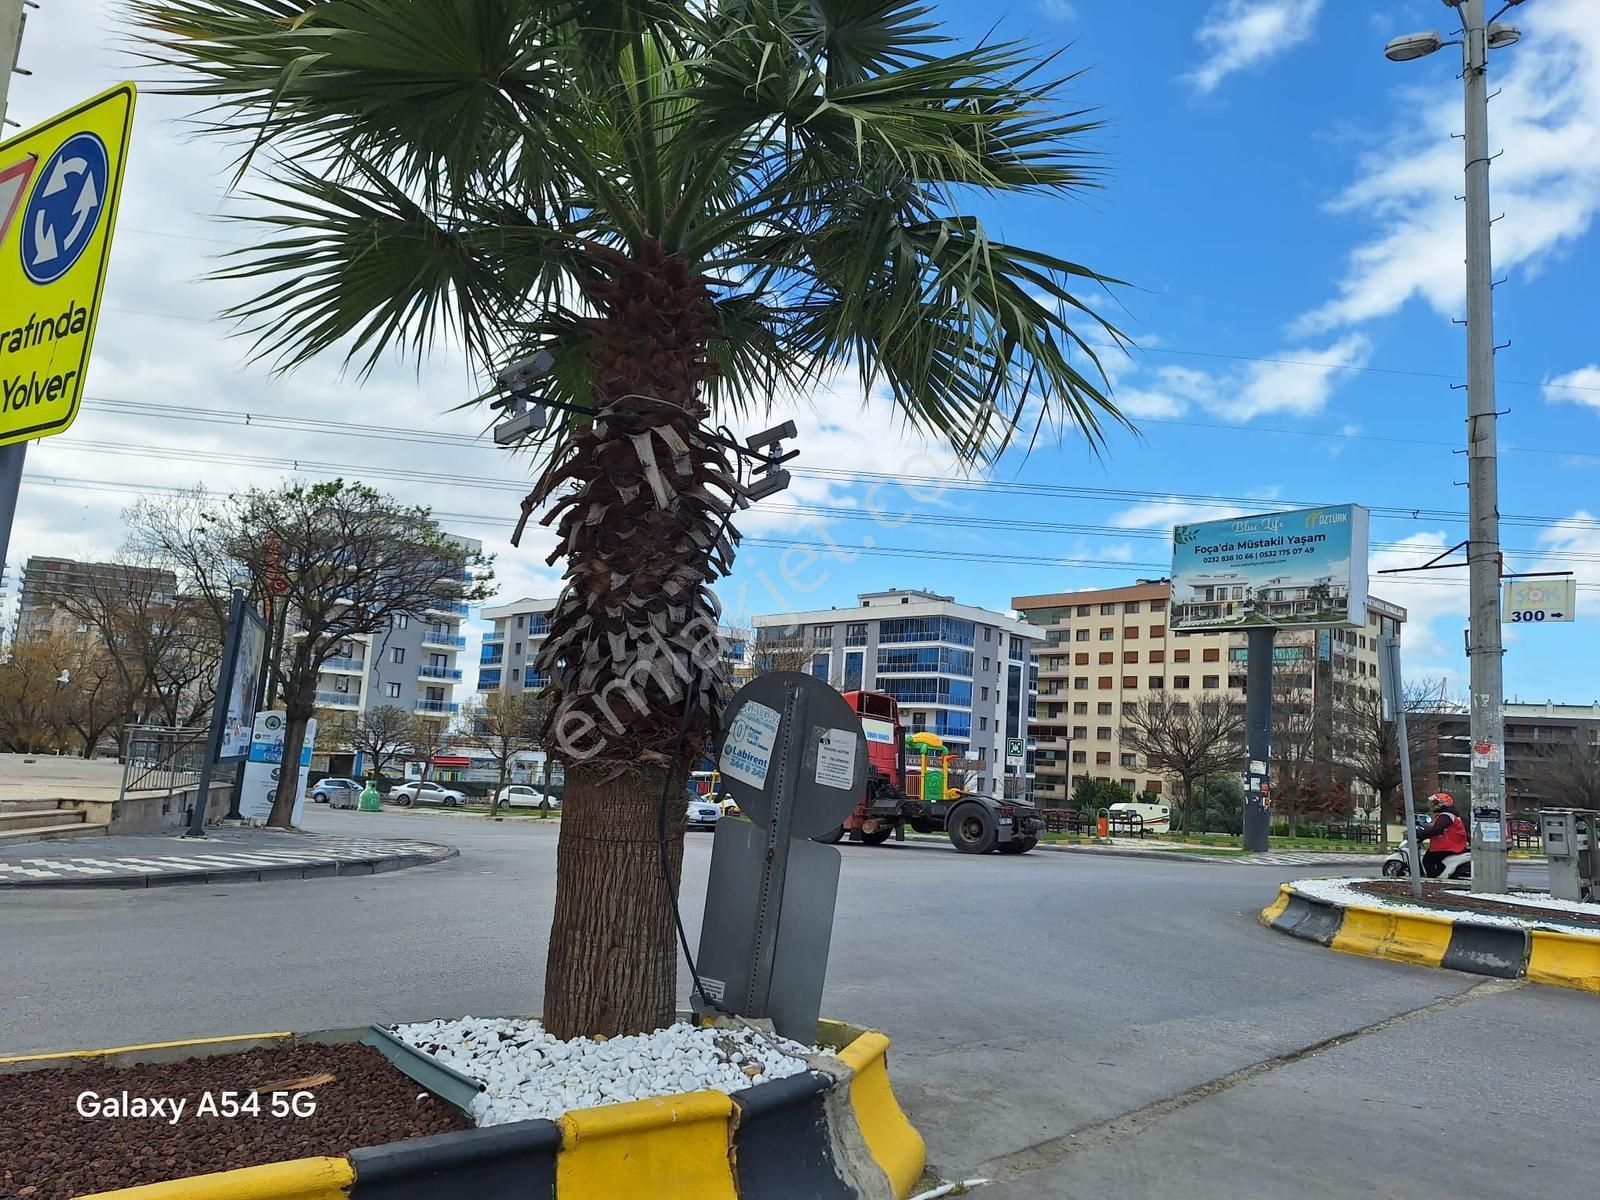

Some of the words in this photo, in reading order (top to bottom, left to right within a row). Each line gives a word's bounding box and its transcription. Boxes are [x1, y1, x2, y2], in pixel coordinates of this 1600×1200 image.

[2, 370, 77, 414] Yolver
[1232, 520, 1259, 533] Blue
[1261, 517, 1285, 533] Life
[1319, 512, 1347, 525] ÖZTÜRK
[1194, 543, 1235, 555] Foça'da
[1237, 536, 1284, 550] Müstakil
[1287, 532, 1326, 545] Yaşam
[1203, 556, 1220, 564] 0232
[1220, 554, 1234, 562] 838
[1244, 552, 1254, 560] 66
[1259, 550, 1277, 558] 0532
[1304, 546, 1314, 554] 49
[1511, 610, 1545, 622] 300
[732, 747, 768, 767] Labirent
